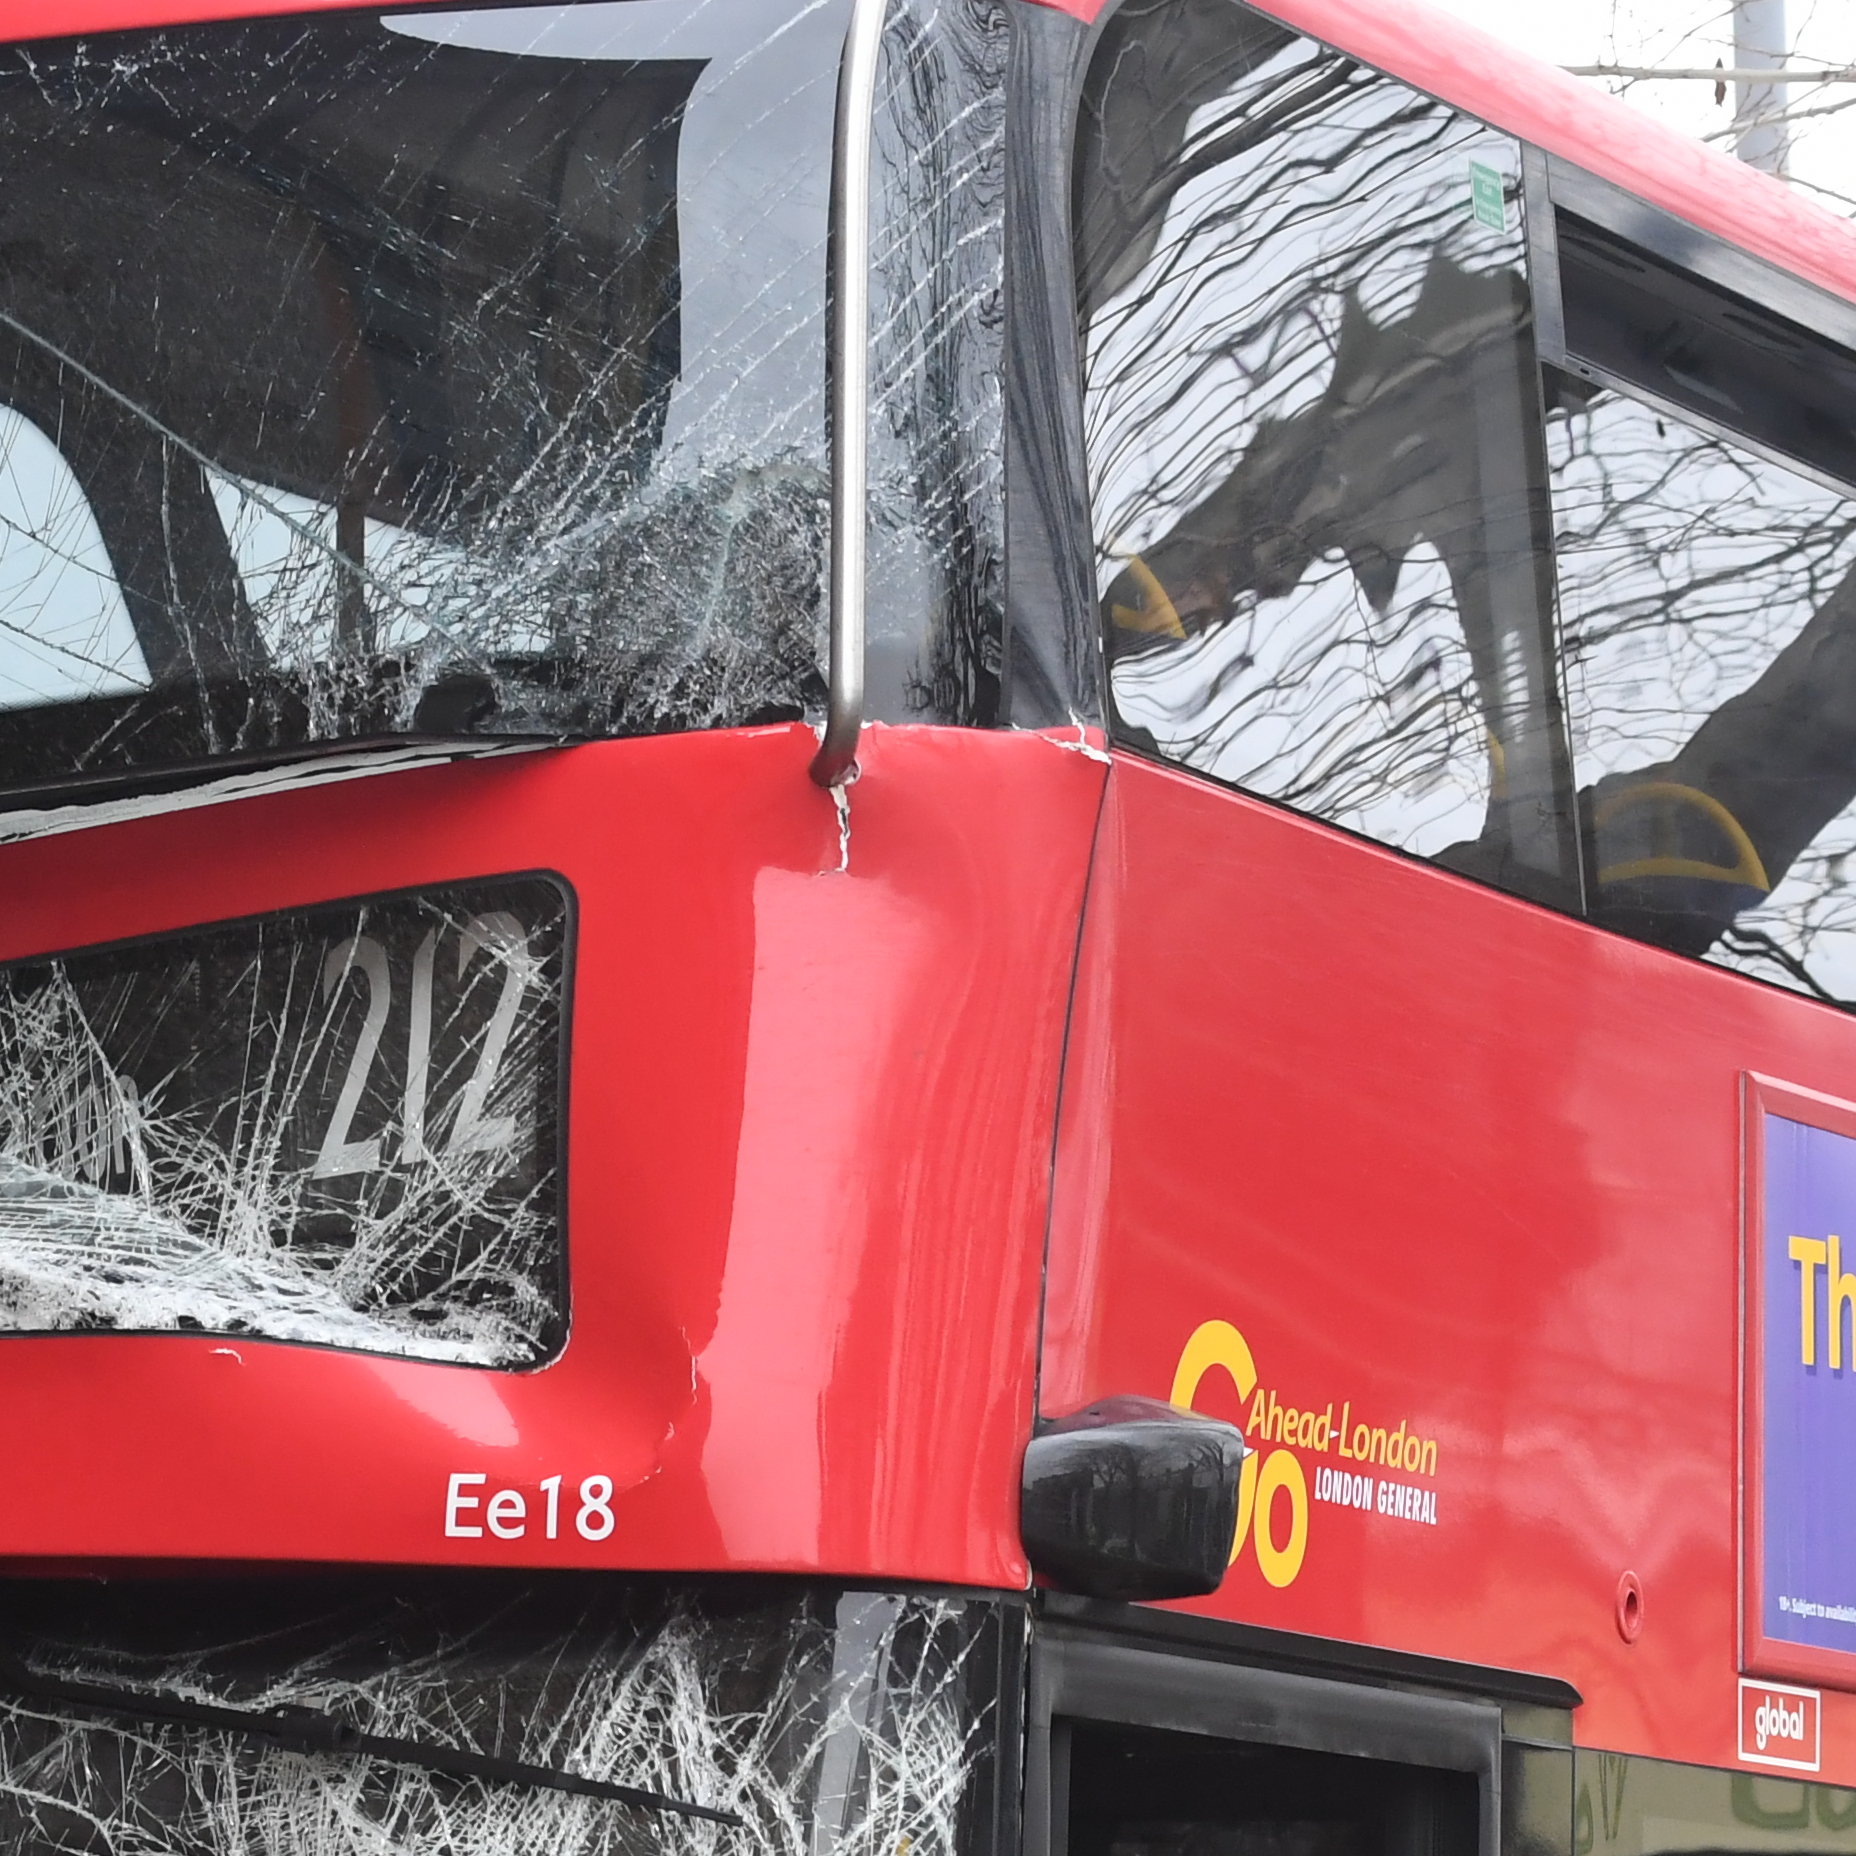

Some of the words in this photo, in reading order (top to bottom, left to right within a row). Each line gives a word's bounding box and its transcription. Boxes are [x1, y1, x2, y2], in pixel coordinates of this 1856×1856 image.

[312, 911, 532, 1180] 212
[1246, 1388, 1437, 1477] Ahead-London
[445, 1472, 616, 1541] Ee18
[1314, 1465, 1373, 1511] LONDON
[1376, 1479, 1437, 1526] GENERAL
[1755, 1696, 1804, 1750] global
